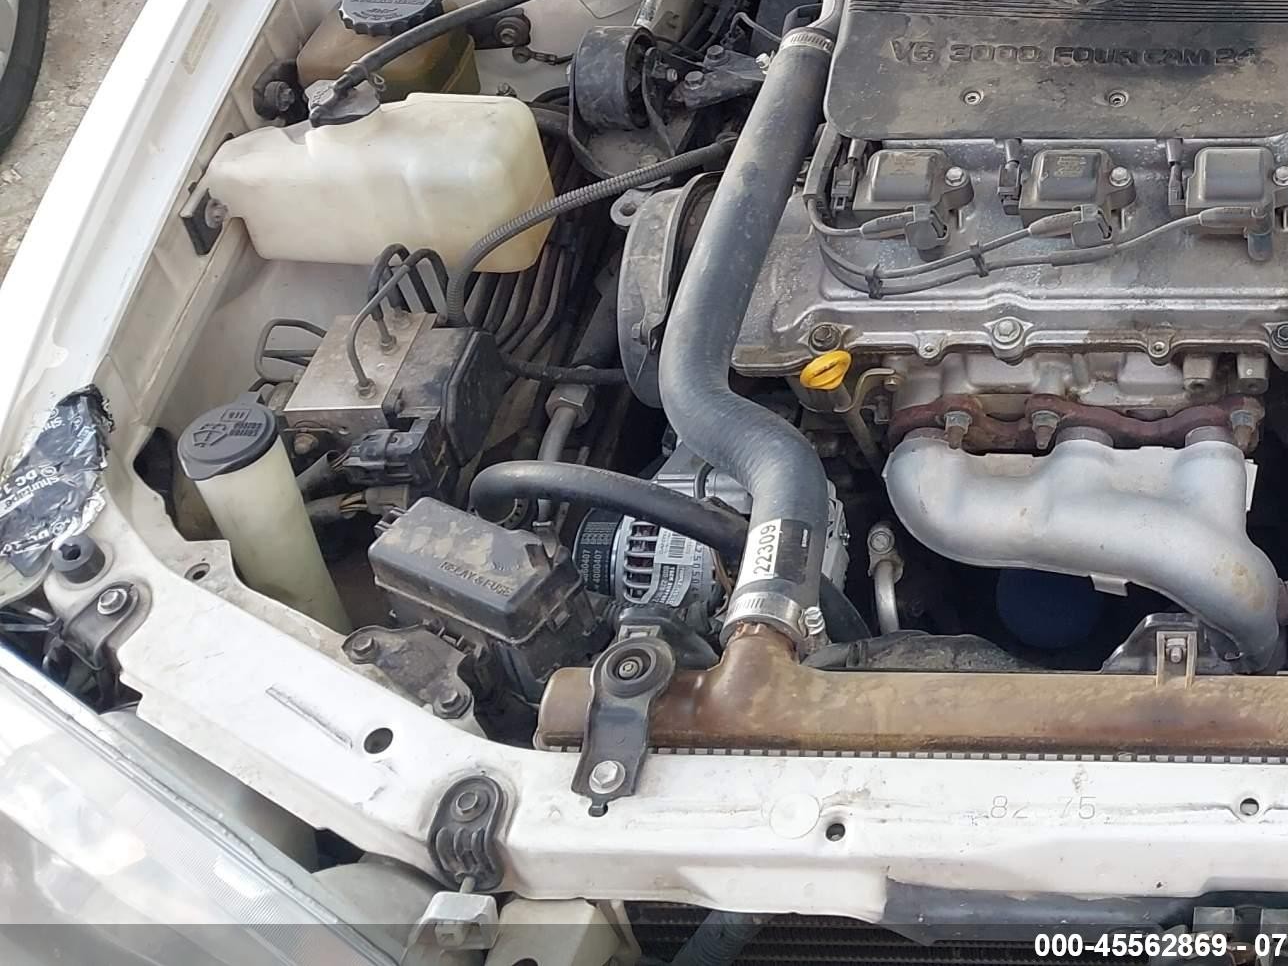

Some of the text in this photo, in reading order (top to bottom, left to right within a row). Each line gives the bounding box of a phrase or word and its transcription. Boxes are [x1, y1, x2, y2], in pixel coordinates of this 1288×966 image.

[890, 39, 1258, 66] V6 3000 FOUR CAM 24
[14, 468, 38, 488] DC
[752, 524, 777, 575] 22309
[439, 560, 475, 581] RELAY
